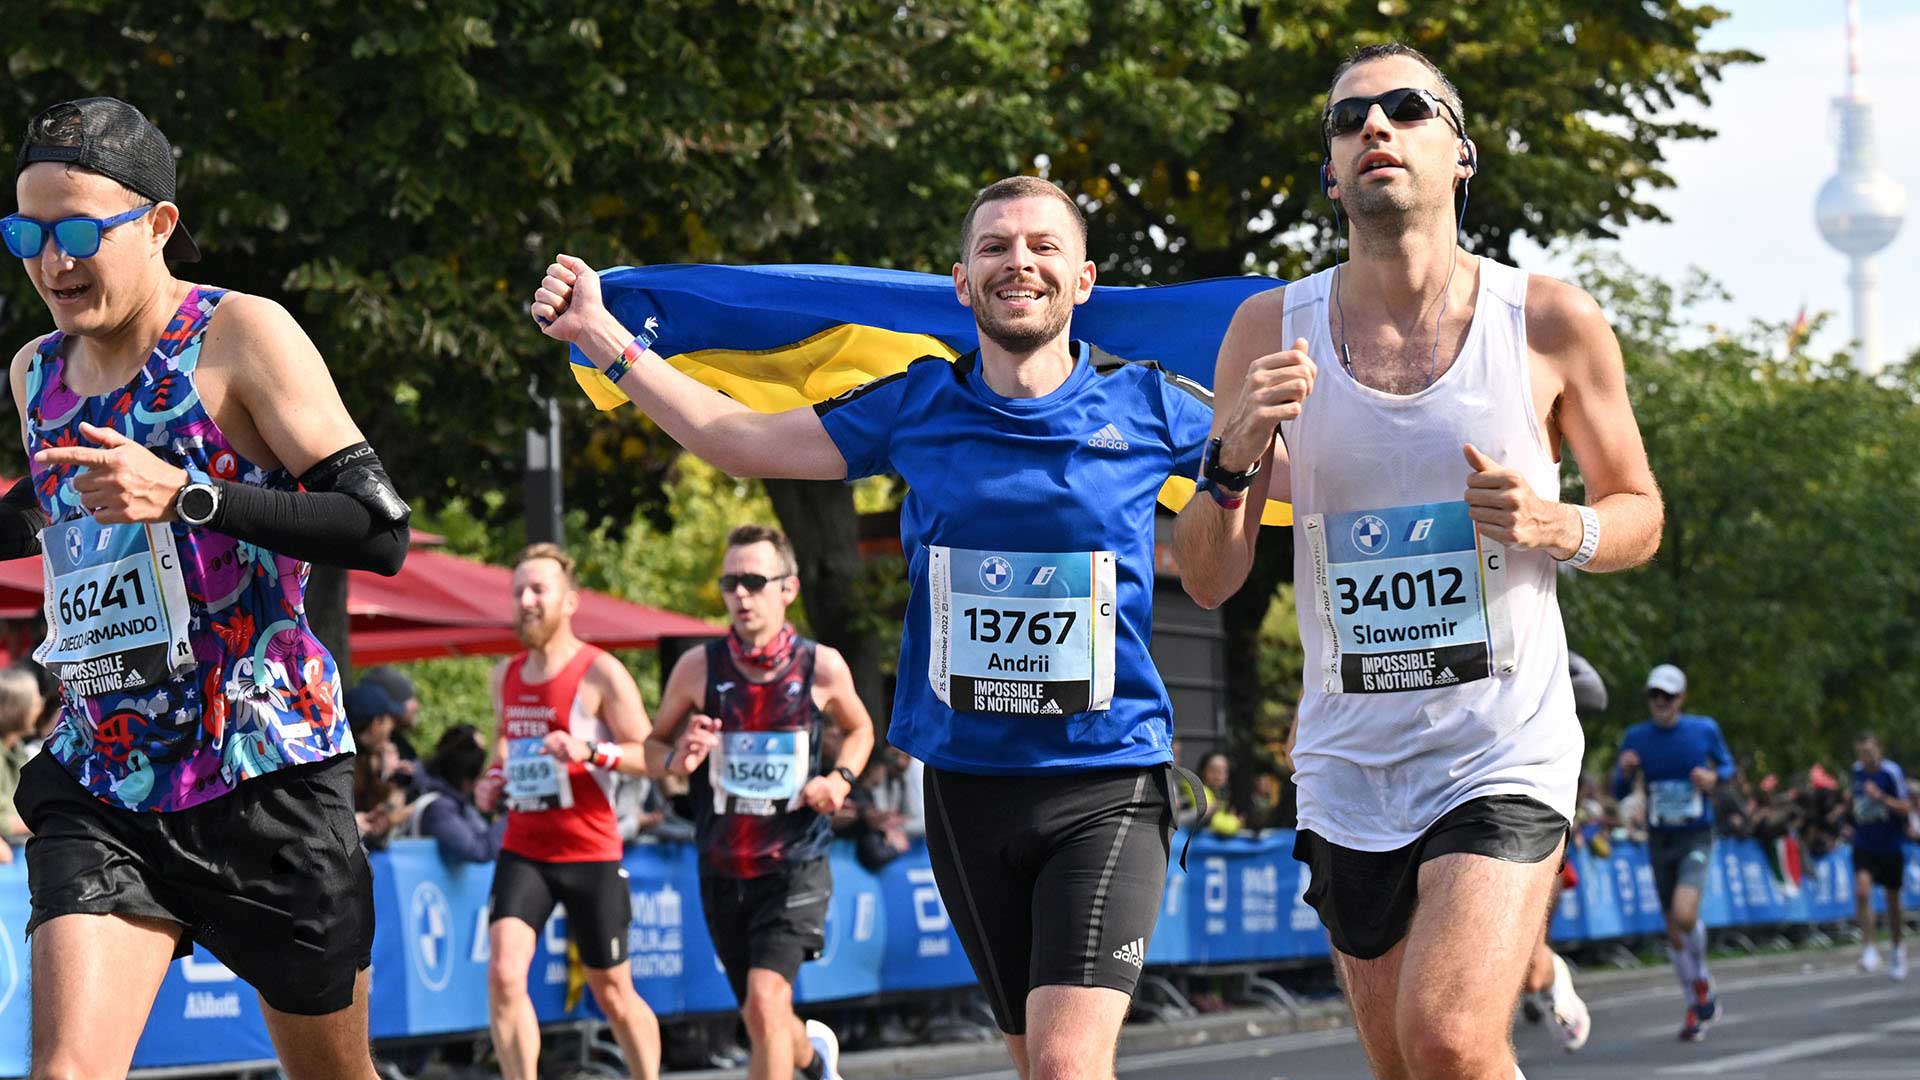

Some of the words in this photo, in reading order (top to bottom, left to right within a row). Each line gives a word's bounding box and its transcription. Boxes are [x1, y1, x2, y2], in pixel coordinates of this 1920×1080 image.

[1087, 438, 1129, 451] adidas
[161, 554, 173, 570] C
[1487, 554, 1500, 570] C
[59, 567, 146, 626] 66241
[1335, 566, 1466, 616] 34012
[1100, 602, 1110, 617] C
[941, 614, 949, 635] 2022
[964, 607, 1077, 645] 13767
[1352, 617, 1458, 645] Slawomir
[58, 633, 85, 652] DIEGO
[60, 654, 125, 681] IMPOSSIBLE
[940, 637, 948, 679] September
[987, 652, 1050, 673] Andrii
[1361, 651, 1437, 673] IMPOSSIBLE
[973, 679, 1044, 699] IMPOSSIBLE
[1362, 674, 1376, 691] IS
[1375, 669, 1434, 690] NOTHING
[974, 695, 986, 711] IS
[987, 696, 1040, 714] NOTHING
[728, 762, 788, 782] 15407
